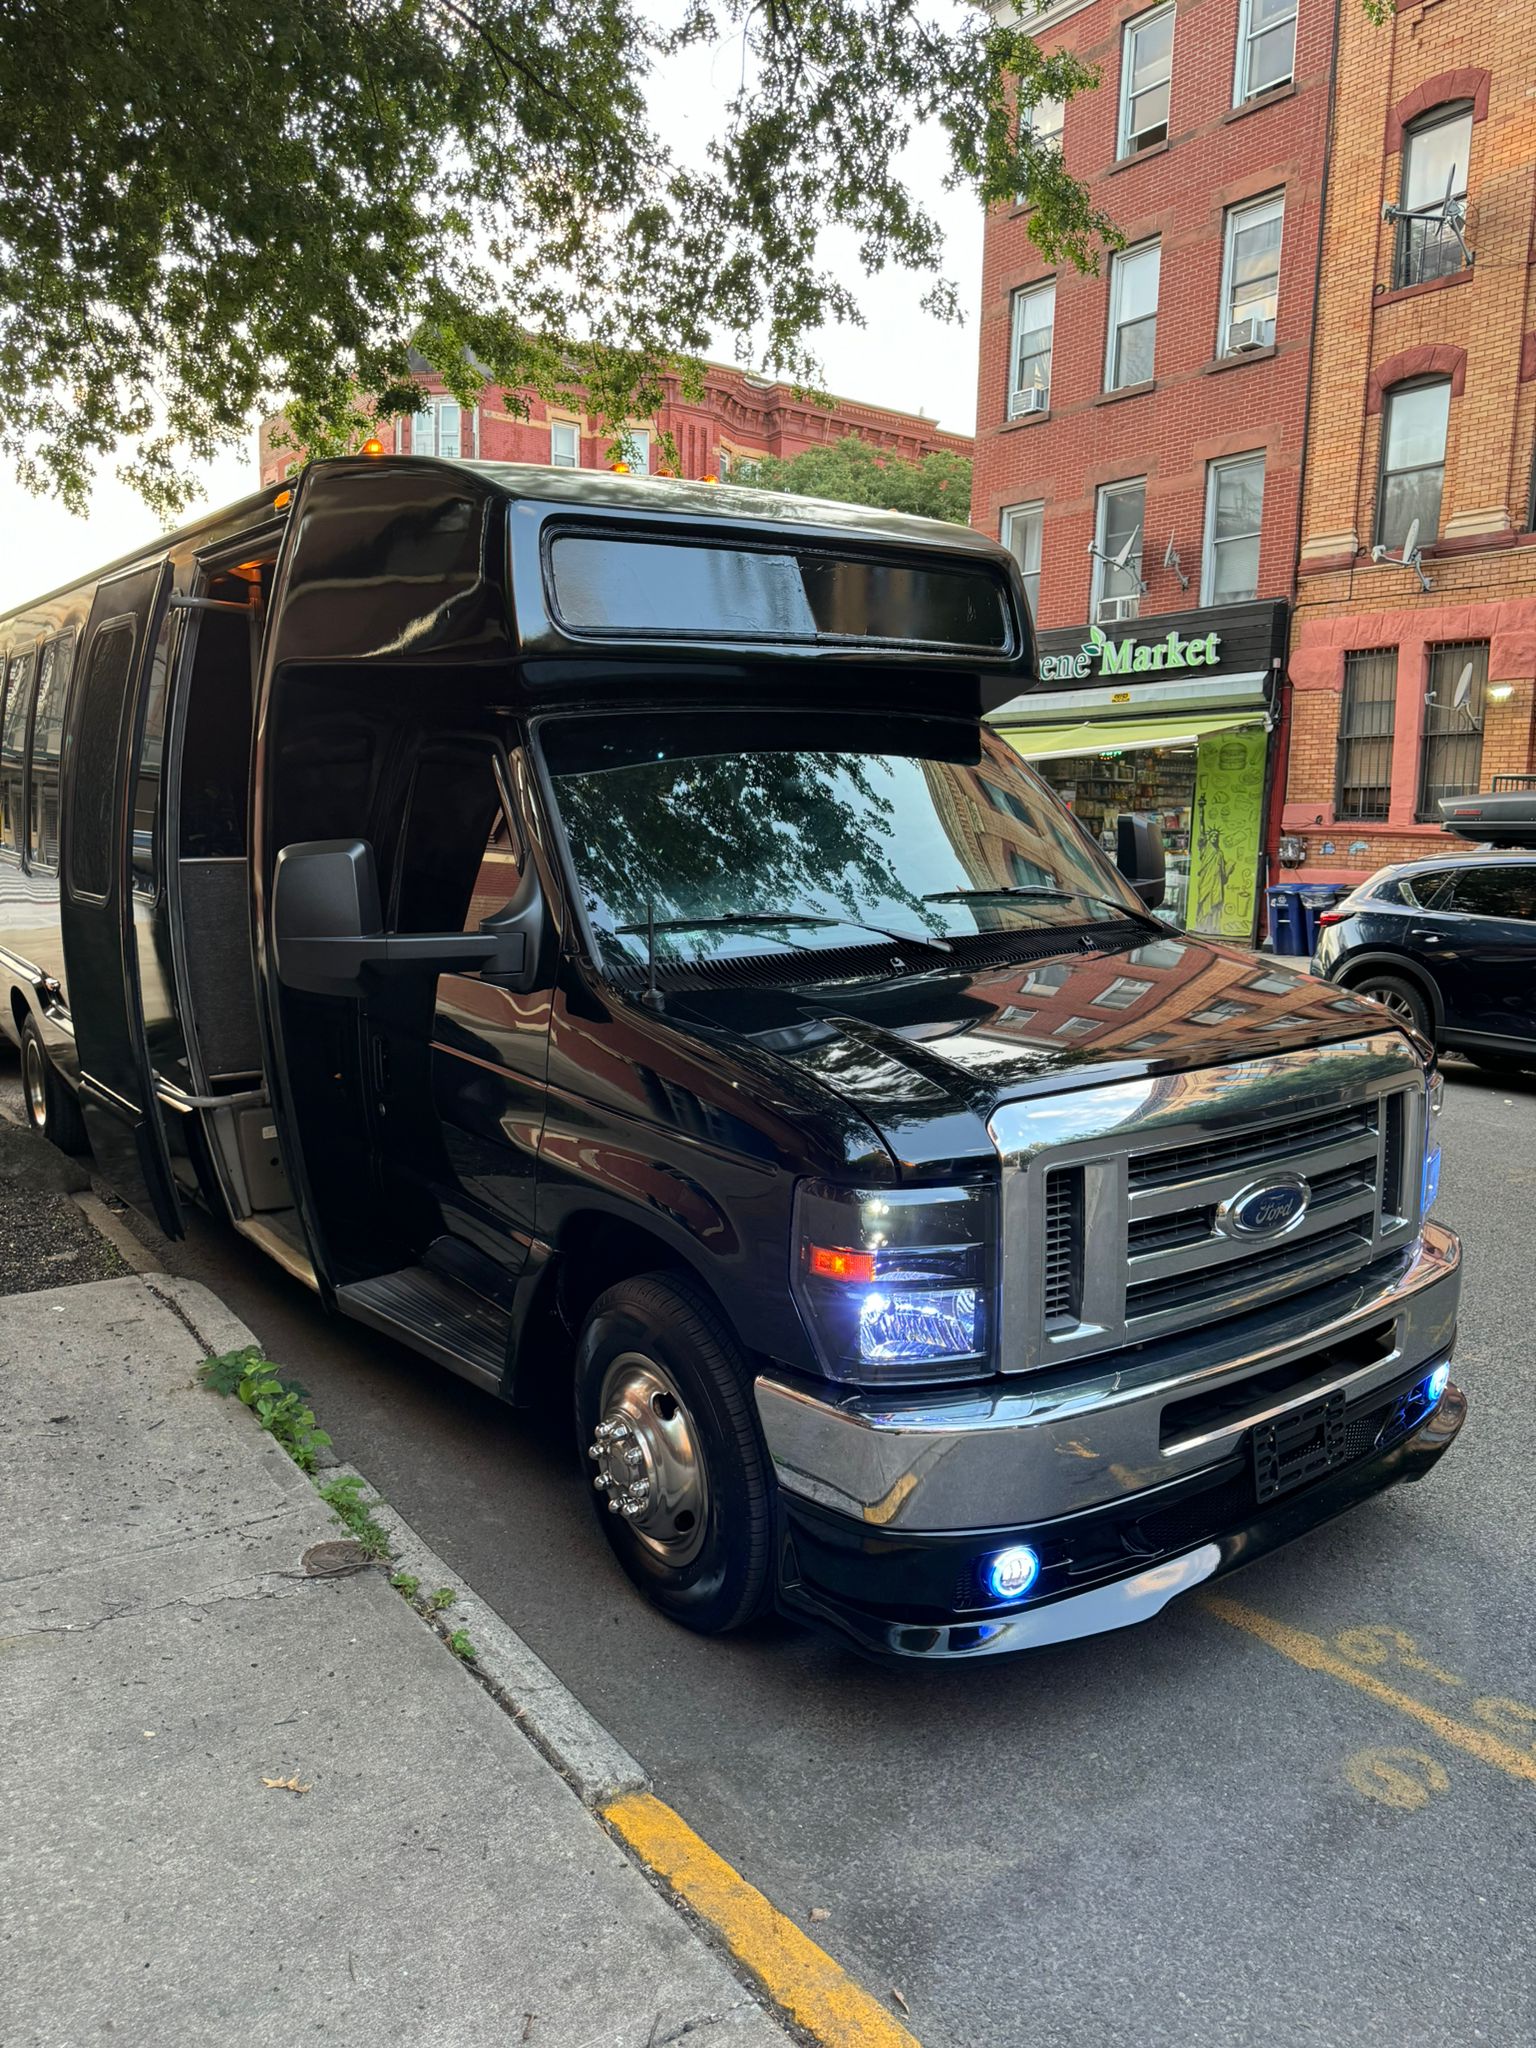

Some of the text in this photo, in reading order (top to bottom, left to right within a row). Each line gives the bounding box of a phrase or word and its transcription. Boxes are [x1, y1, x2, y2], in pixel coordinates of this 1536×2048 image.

[1039, 631, 1221, 681] ene Market
[1255, 1194, 1294, 1225] Ford
